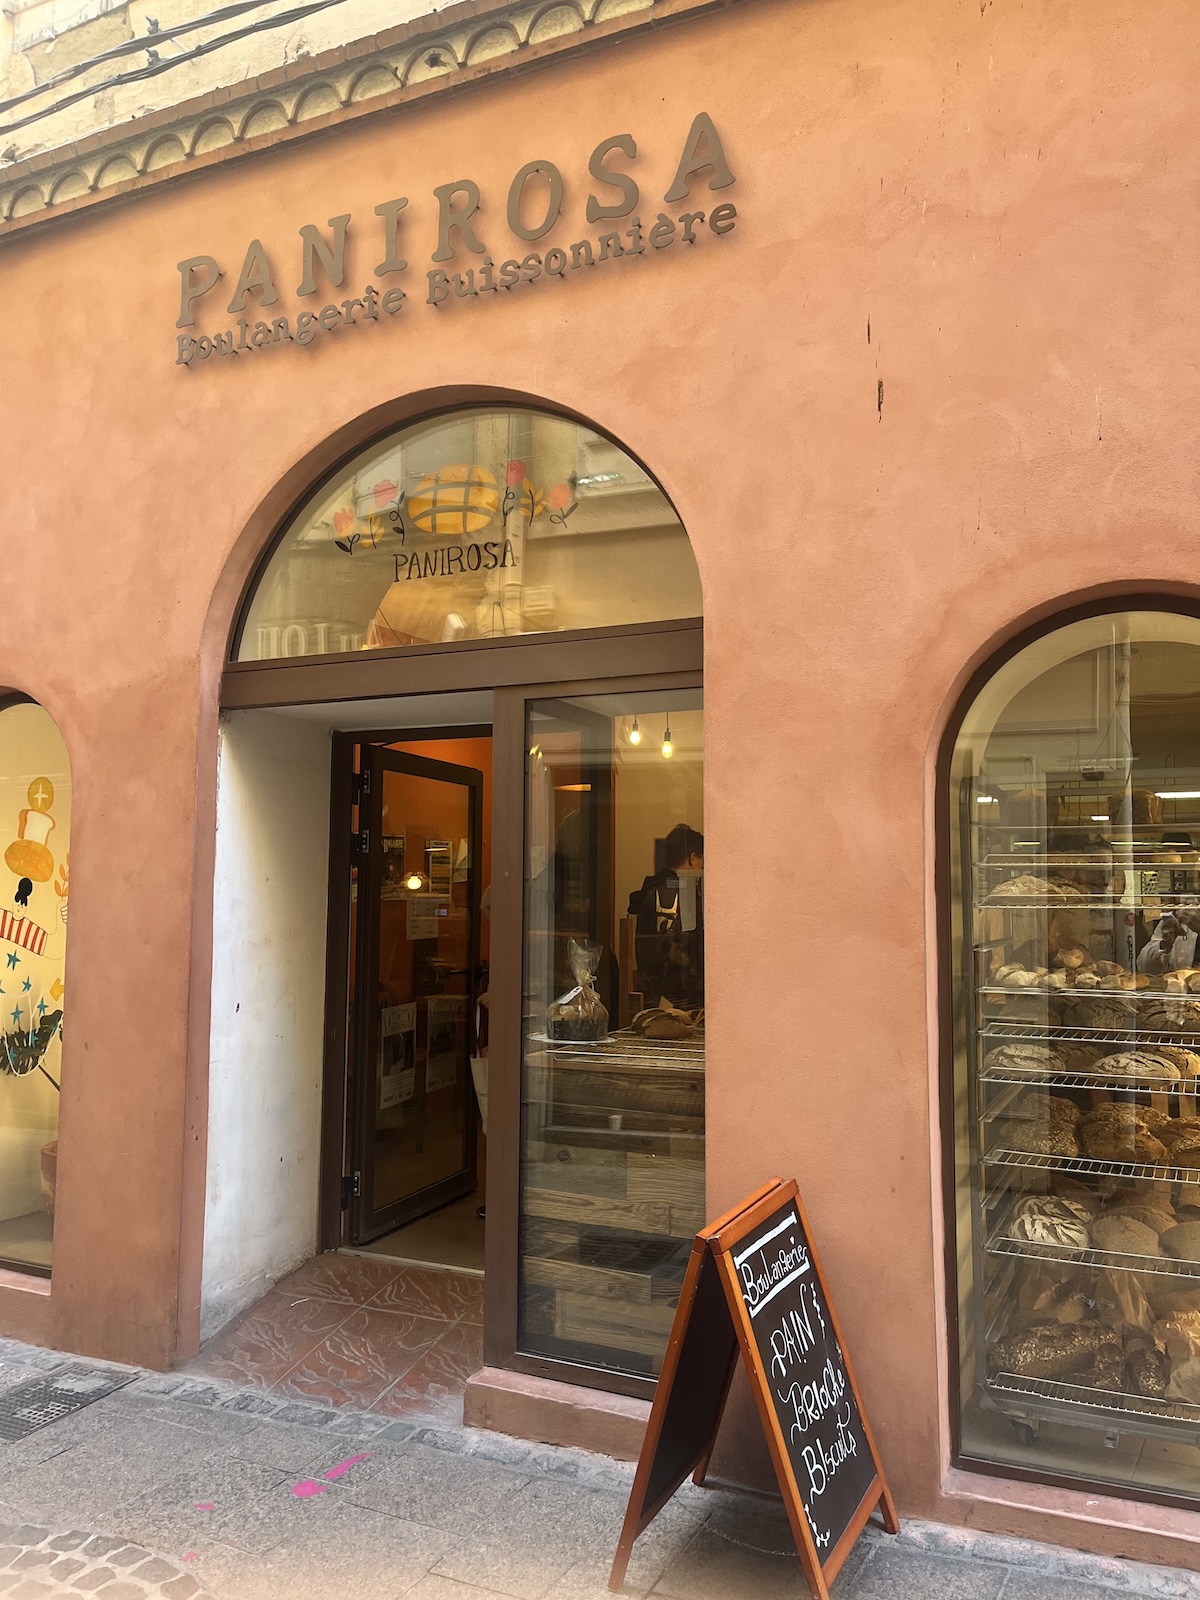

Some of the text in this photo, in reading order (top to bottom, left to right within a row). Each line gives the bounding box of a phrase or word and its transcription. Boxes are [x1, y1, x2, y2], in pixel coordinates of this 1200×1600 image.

[176, 111, 736, 329] PANIROSA
[176, 203, 737, 365] Boulangerie Buissonnière
[392, 538, 518, 582] PANIROSA
[771, 1283, 816, 1379] PAIN
